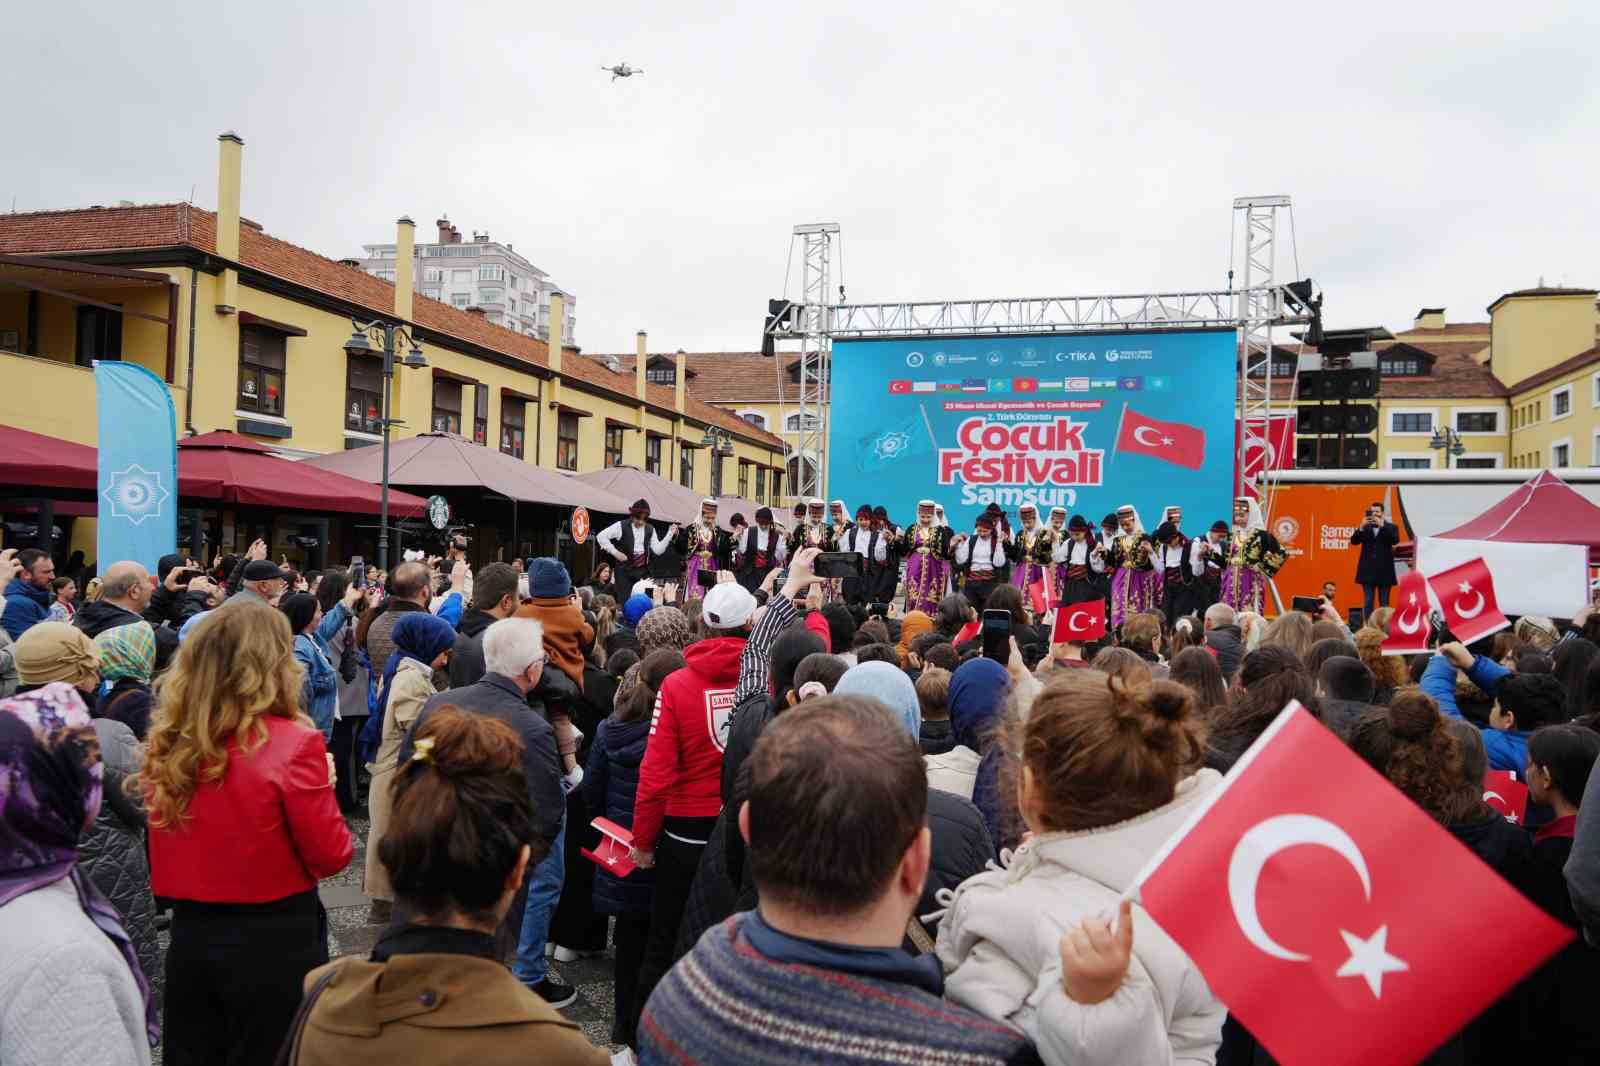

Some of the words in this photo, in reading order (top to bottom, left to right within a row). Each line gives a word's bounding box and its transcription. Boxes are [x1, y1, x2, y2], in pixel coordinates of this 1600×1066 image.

[1069, 350, 1096, 361] TİKA
[958, 418, 1084, 457] Çocuk
[941, 451, 1101, 484] Festivali
[960, 485, 1077, 506] Samsun
[1321, 524, 1358, 538] Samsu
[713, 696, 736, 705] SAMS
